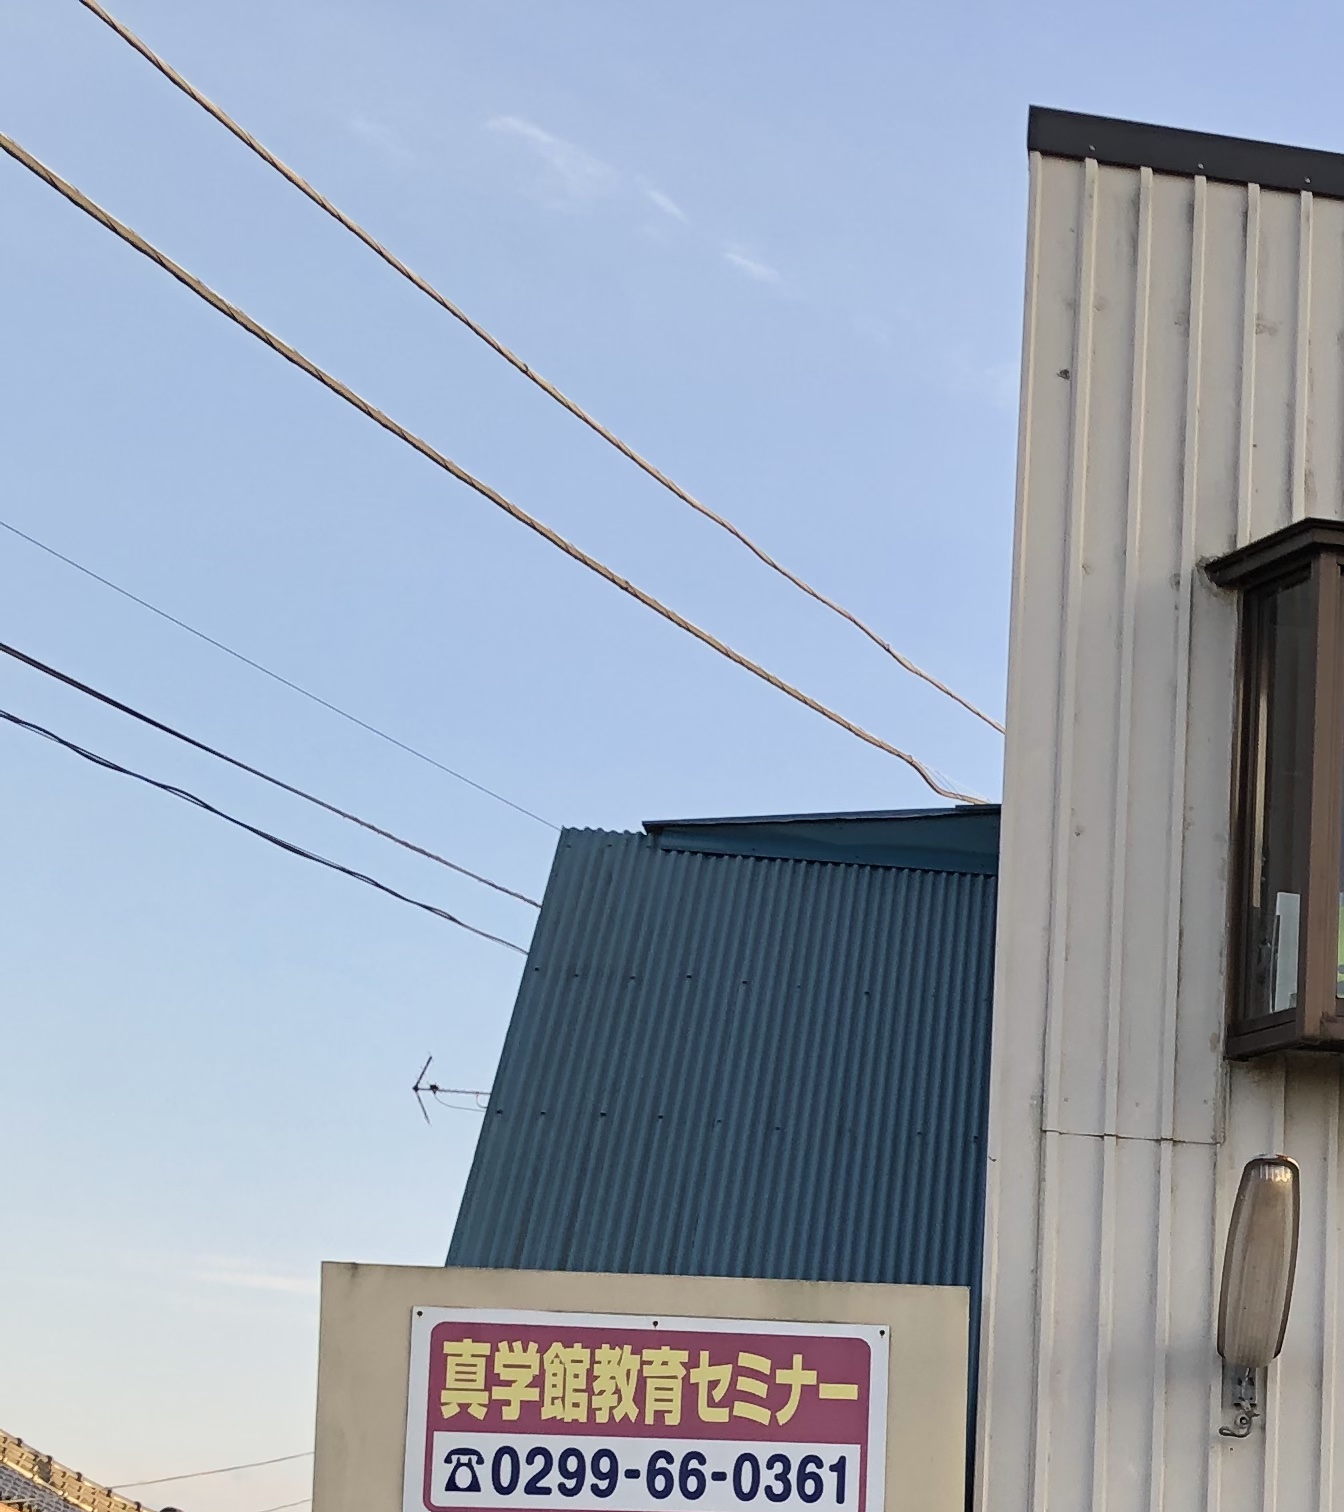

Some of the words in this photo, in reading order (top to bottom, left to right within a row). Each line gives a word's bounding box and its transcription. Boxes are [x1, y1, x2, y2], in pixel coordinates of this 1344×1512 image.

[440, 1339, 859, 1427] 真学館教育セミナー
[491, 1445, 848, 1505] 0299-66-0361
